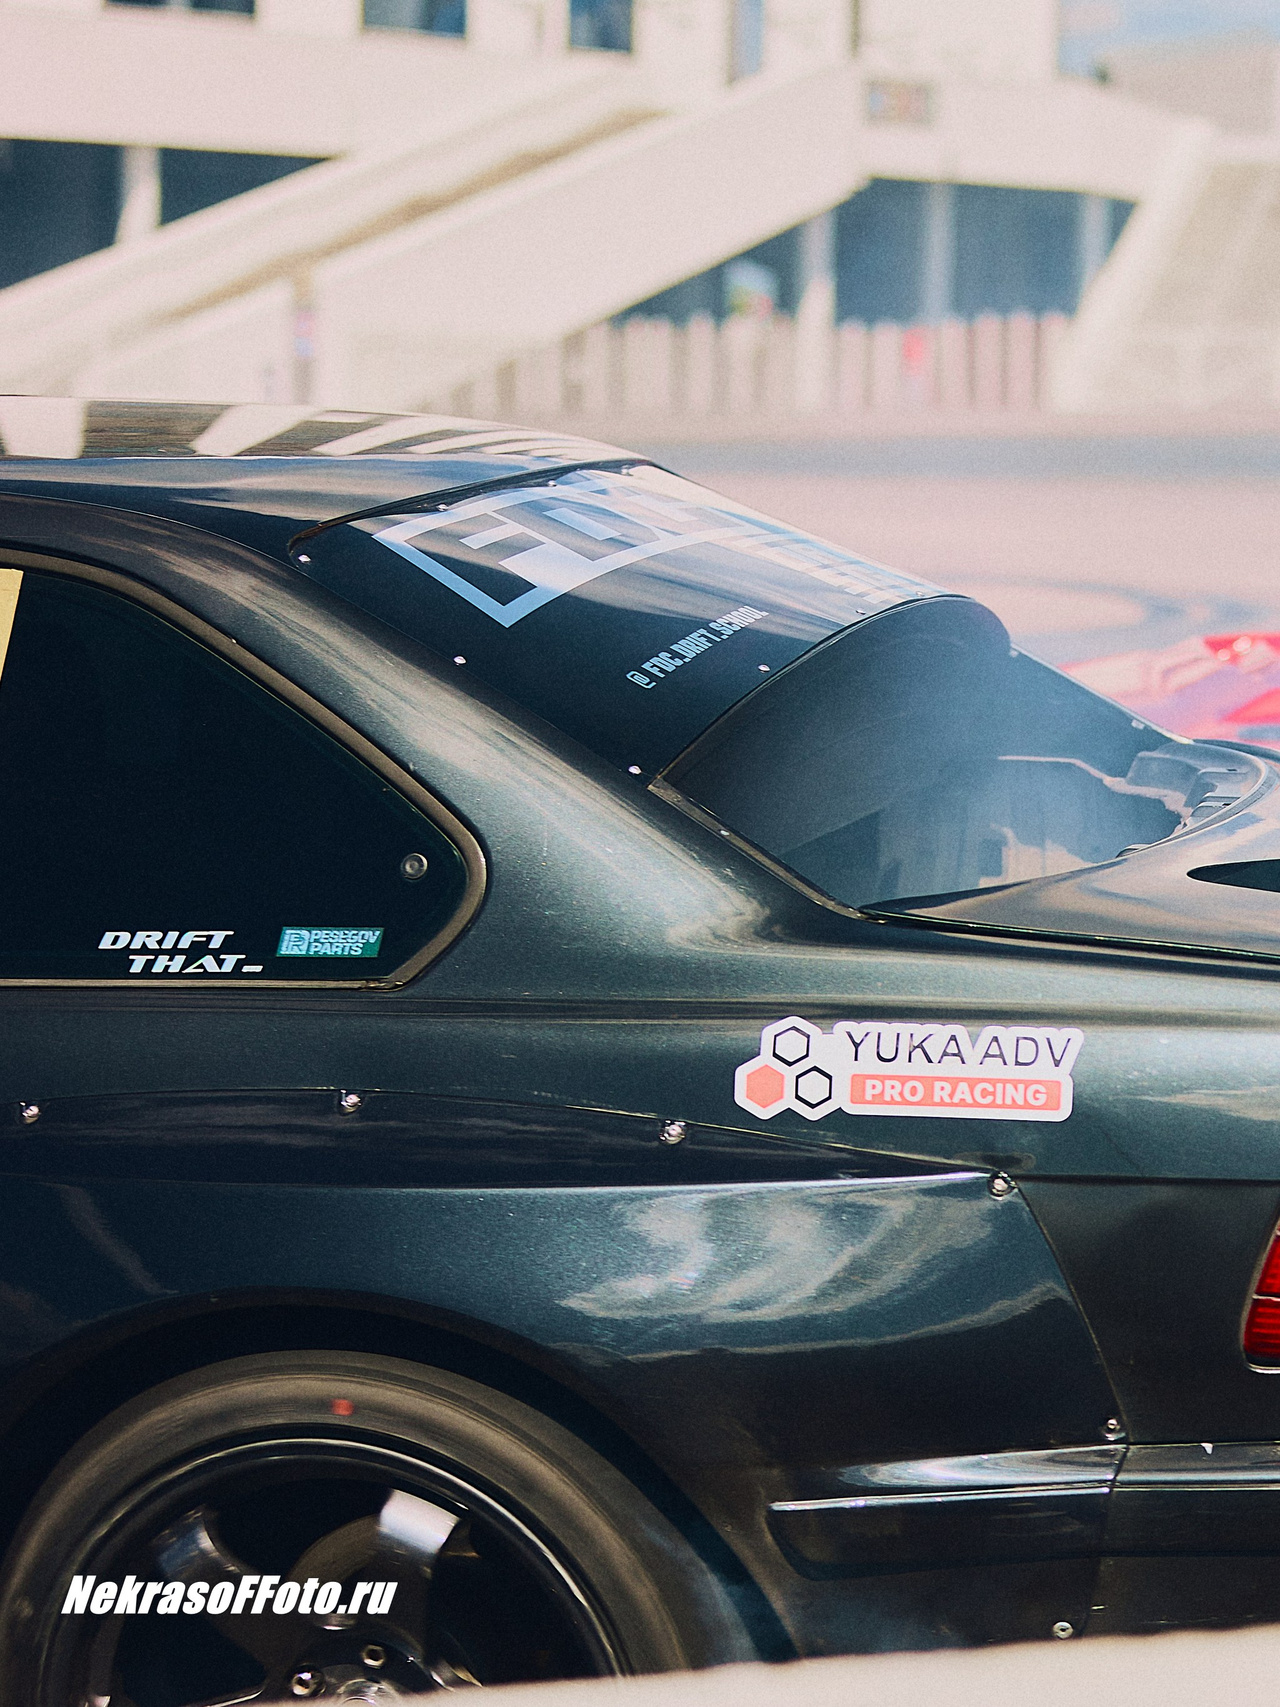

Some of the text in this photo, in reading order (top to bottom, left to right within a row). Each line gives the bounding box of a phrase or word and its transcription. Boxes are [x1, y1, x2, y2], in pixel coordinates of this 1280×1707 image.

[98, 930, 234, 949] DRIFT
[309, 943, 363, 955] PARTS
[846, 1030, 1072, 1068] YUKA ADV
[865, 1079, 1048, 1106] PRO RACING
